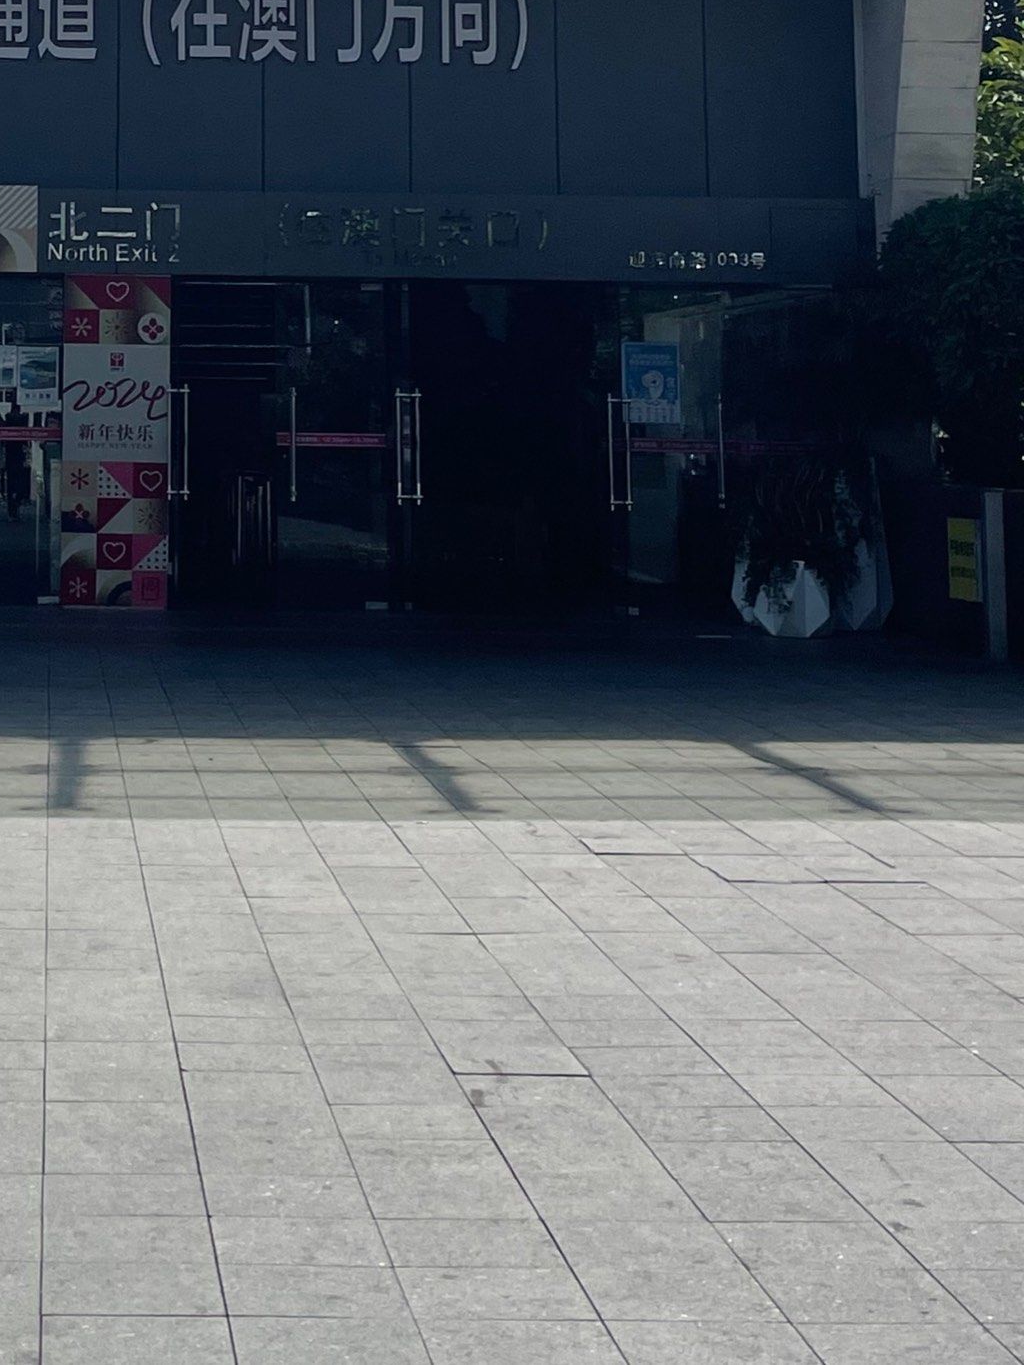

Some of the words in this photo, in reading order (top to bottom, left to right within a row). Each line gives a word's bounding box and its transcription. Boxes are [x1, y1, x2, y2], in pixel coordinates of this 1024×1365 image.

[48, 201, 181, 241] 北二门
[47, 242, 108, 262] North
[115, 243, 158, 262] Exit
[168, 244, 180, 262] 2
[78, 423, 154, 442] 新年快乐
